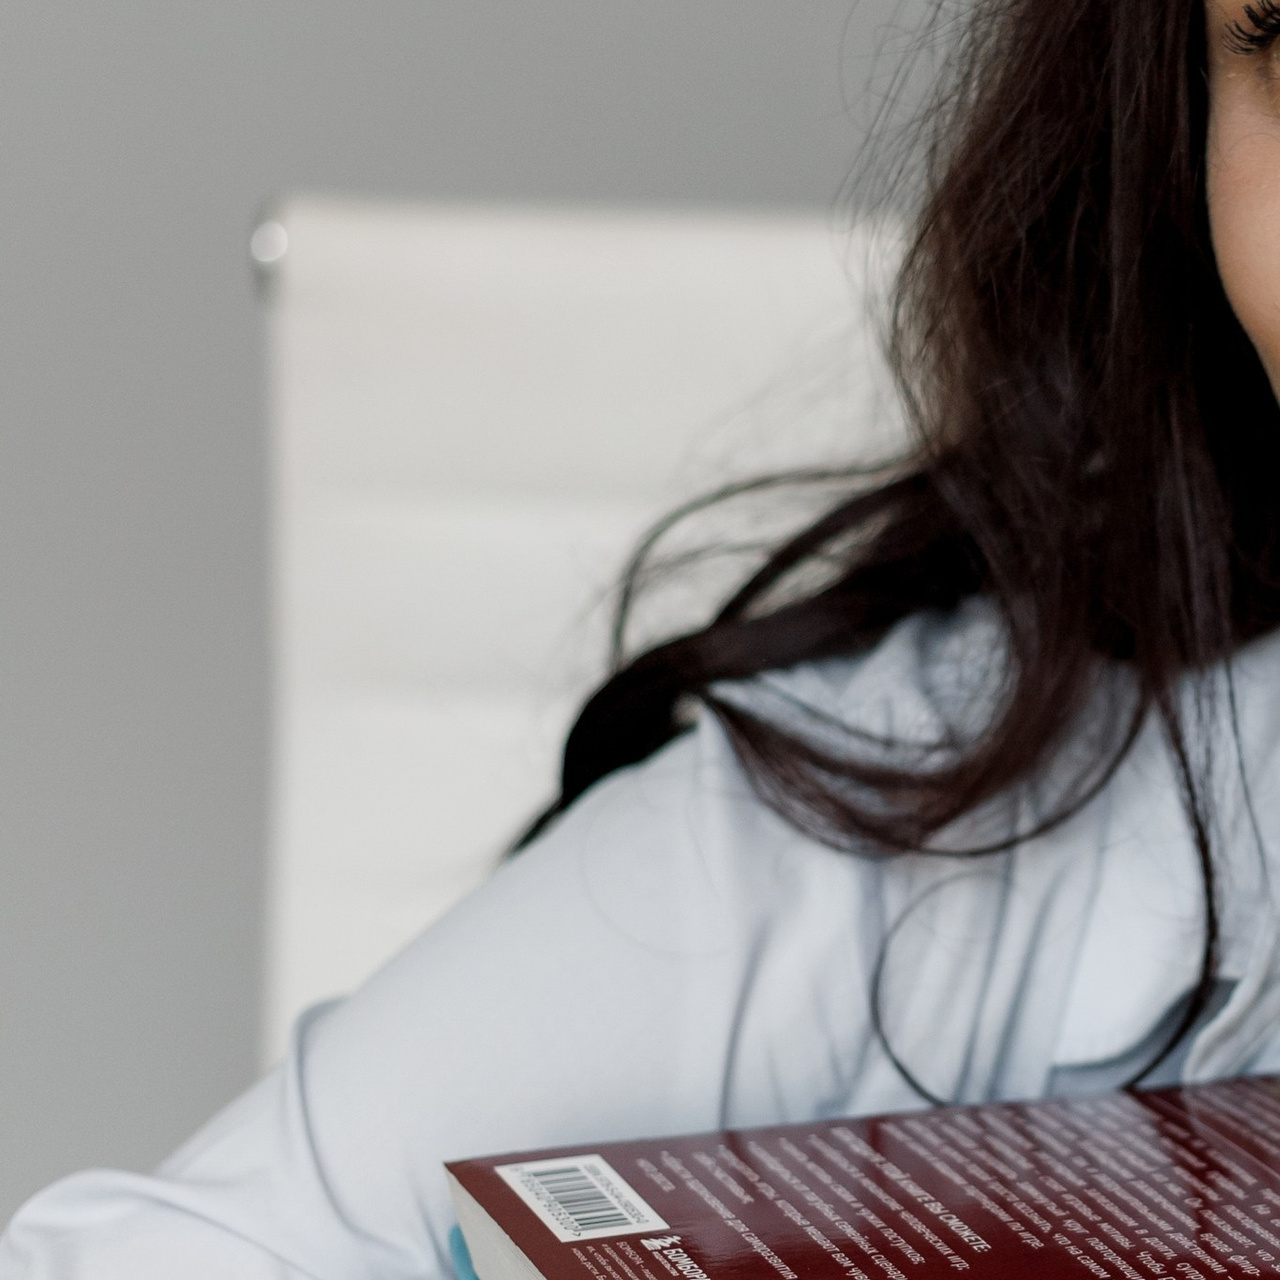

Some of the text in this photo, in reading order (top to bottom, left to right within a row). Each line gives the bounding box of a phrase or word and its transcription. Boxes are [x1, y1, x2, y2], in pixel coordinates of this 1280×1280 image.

[880, 1227, 925, 1265] поступков;
[938, 1213, 992, 1253] СМОЖЕТЕ:
[1017, 1231, 1045, 1250] игре.
[741, 1232, 798, 1280] саморазвития
[831, 1252, 855, 1267] вам
[1052, 1232, 1072, 1246] что
[1076, 1255, 1111, 1279] самом
[1136, 1250, 1167, 1275] Чтобы
[1165, 1232, 1228, 1274] действиями
[1255, 1248, 1276, 1262] что
